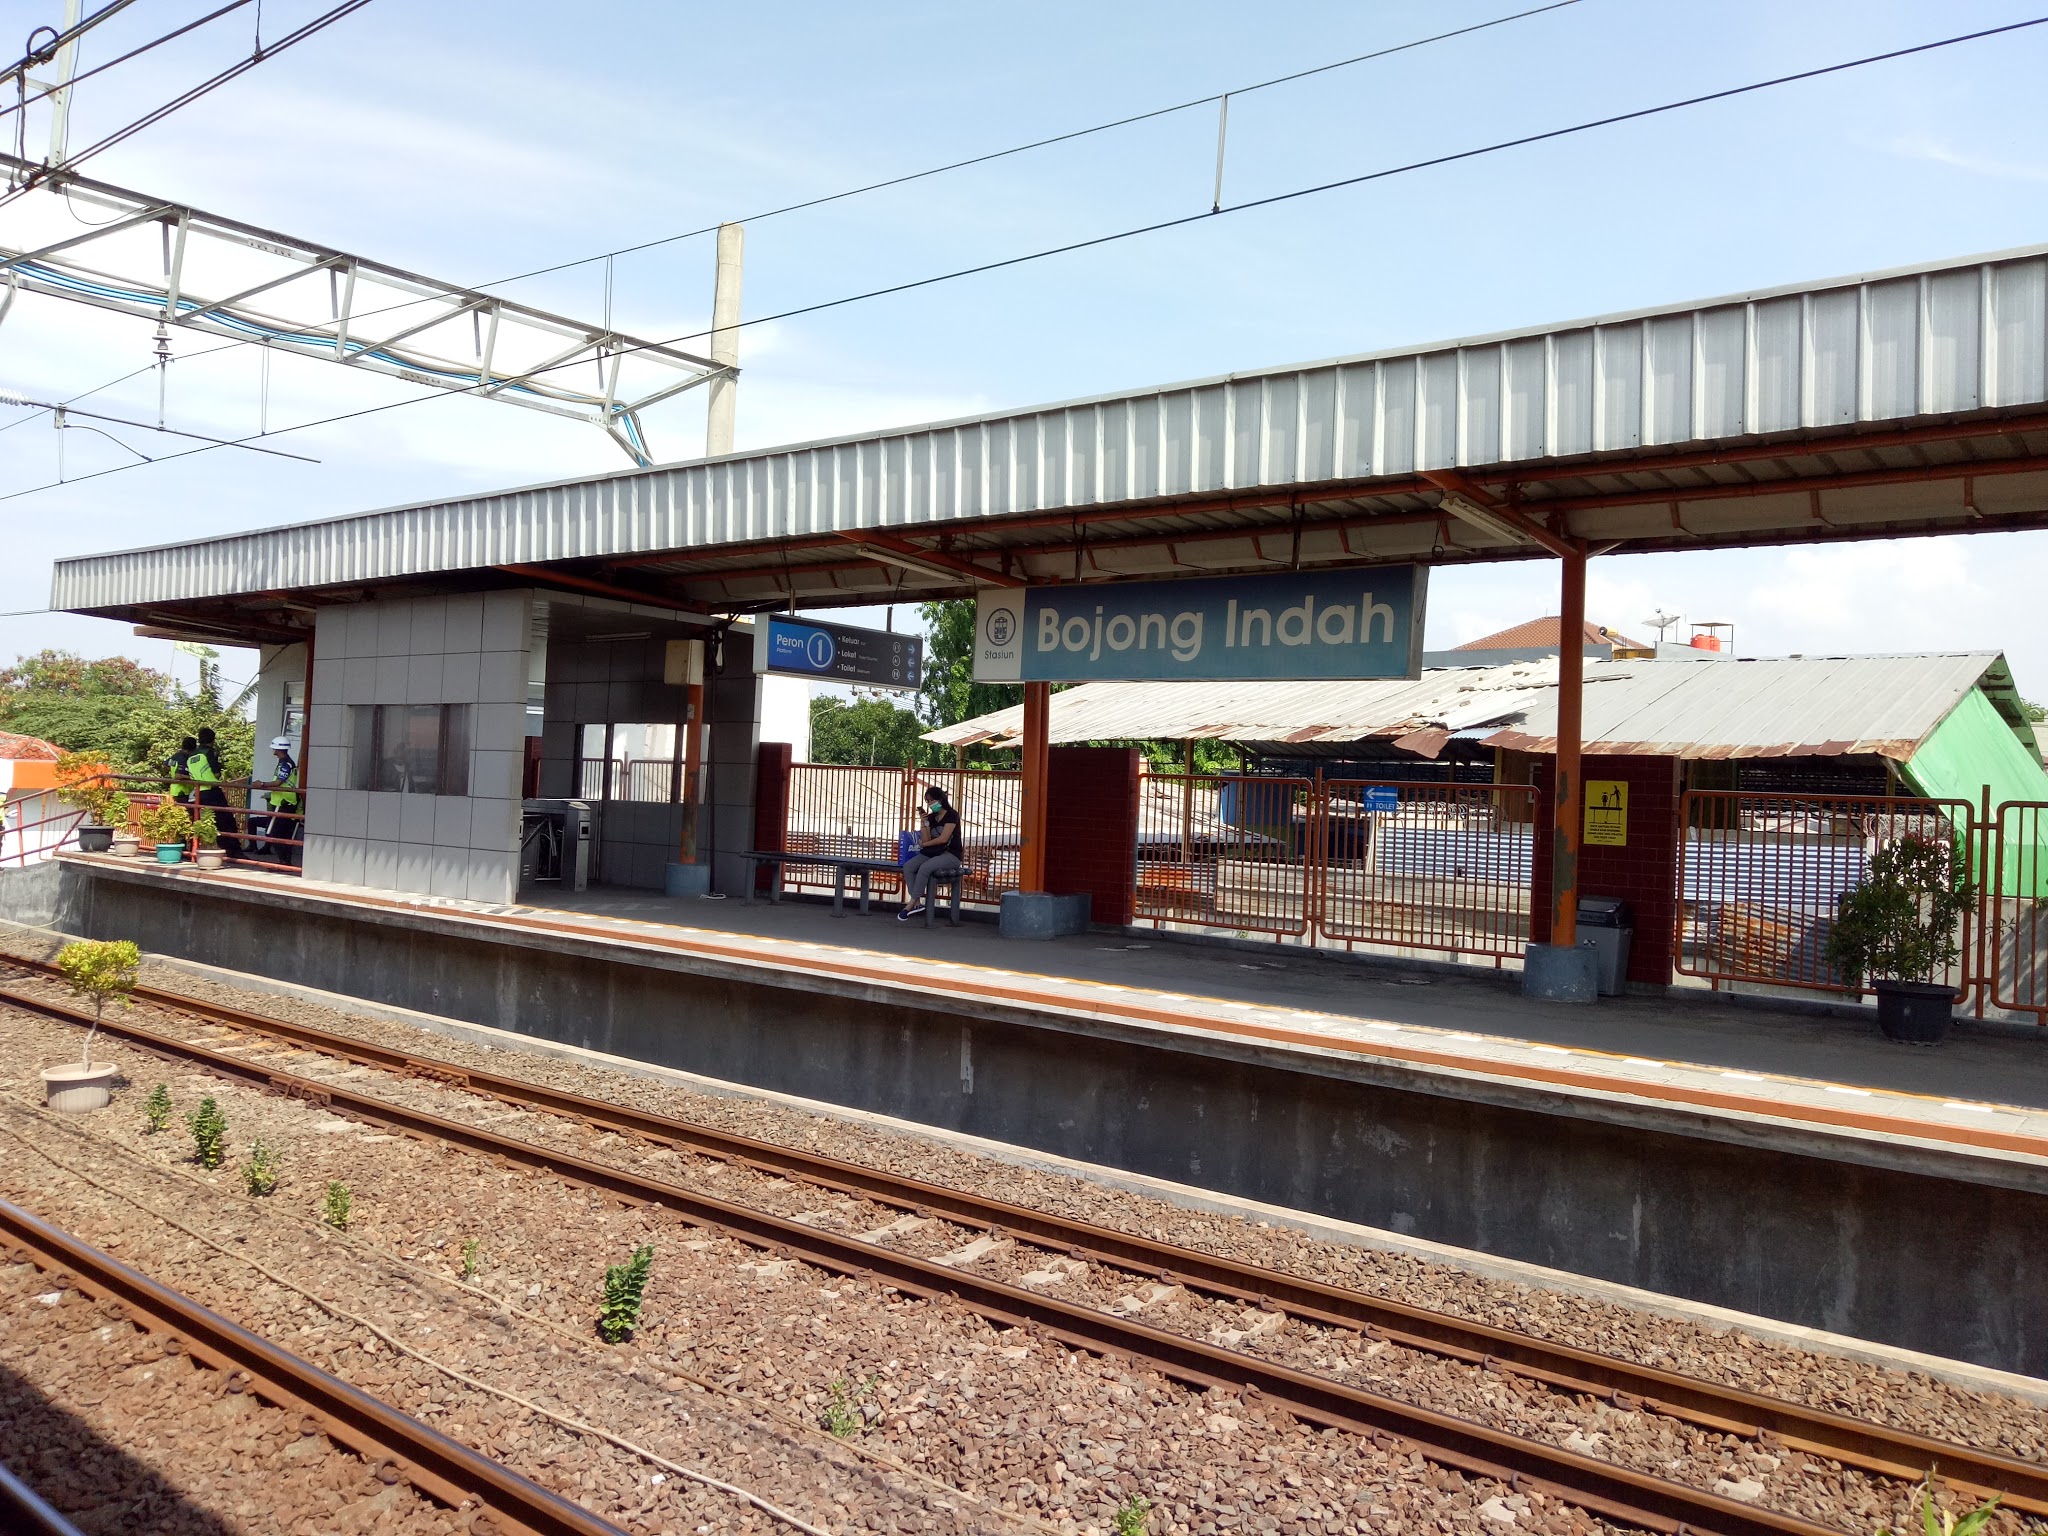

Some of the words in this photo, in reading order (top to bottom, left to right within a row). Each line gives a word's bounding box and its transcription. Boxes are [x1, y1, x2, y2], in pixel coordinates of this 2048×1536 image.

[1037, 606, 1204, 662] Bojong
[1226, 592, 1395, 648] Indah
[776, 633, 804, 648] Peron
[841, 635, 860, 645] Keluar
[817, 639, 823, 661] 1
[841, 650, 857, 659] Loket
[984, 650, 1014, 660] Stasiun
[840, 663, 856, 673] Toilet
[1375, 802, 1395, 810] TOILET
